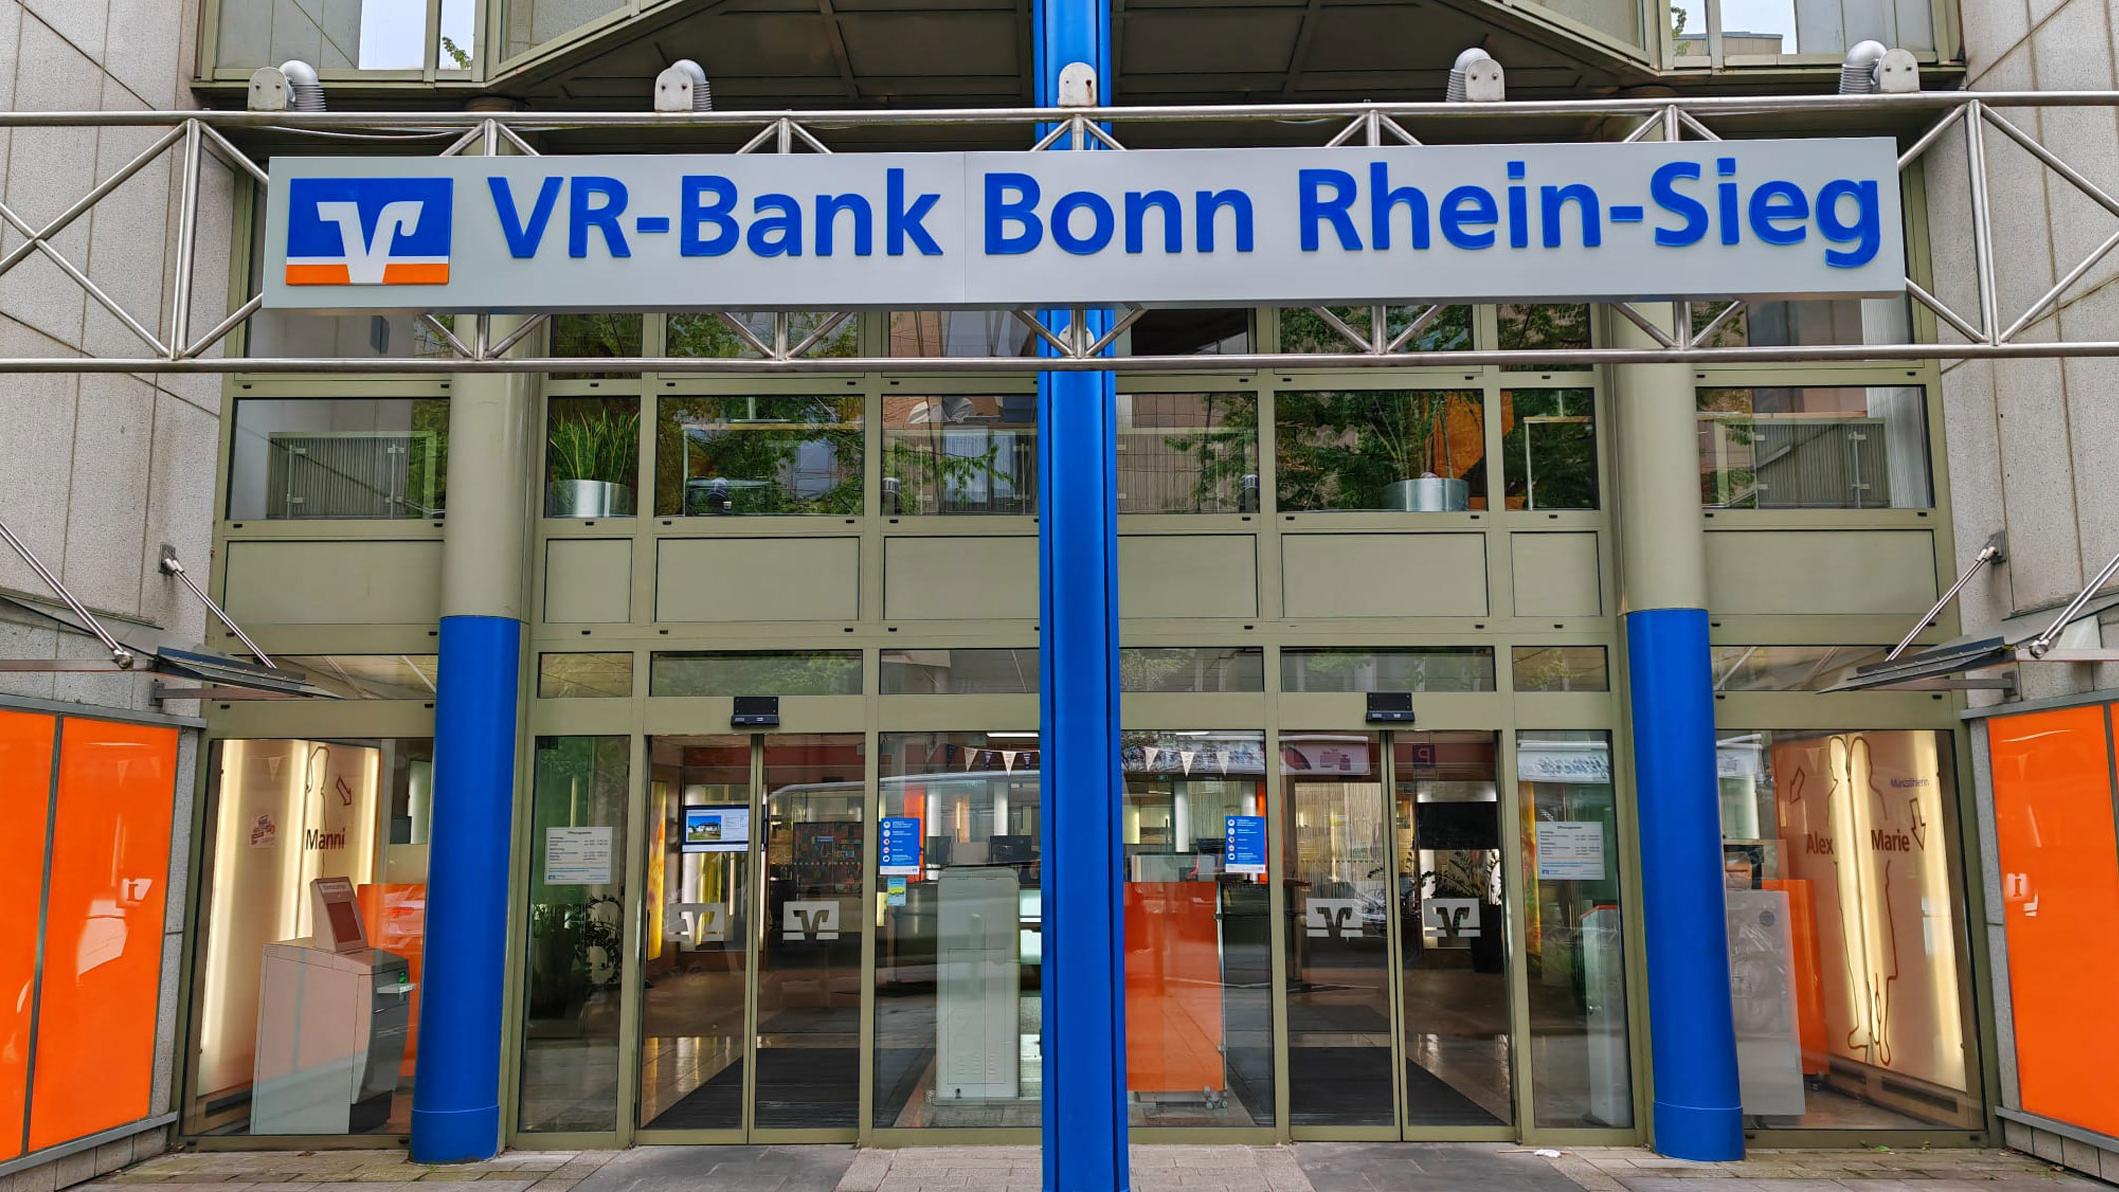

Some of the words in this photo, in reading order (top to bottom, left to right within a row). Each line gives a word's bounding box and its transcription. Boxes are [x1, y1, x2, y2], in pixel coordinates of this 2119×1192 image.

[487, 168, 943, 258] VR-Bank
[984, 172, 1255, 256] Bonn
[1298, 157, 1881, 268] Rhein-Sieg
[305, 827, 346, 850] Manni
[1806, 832, 1834, 855] Alex
[1871, 829, 1910, 852] Marie
